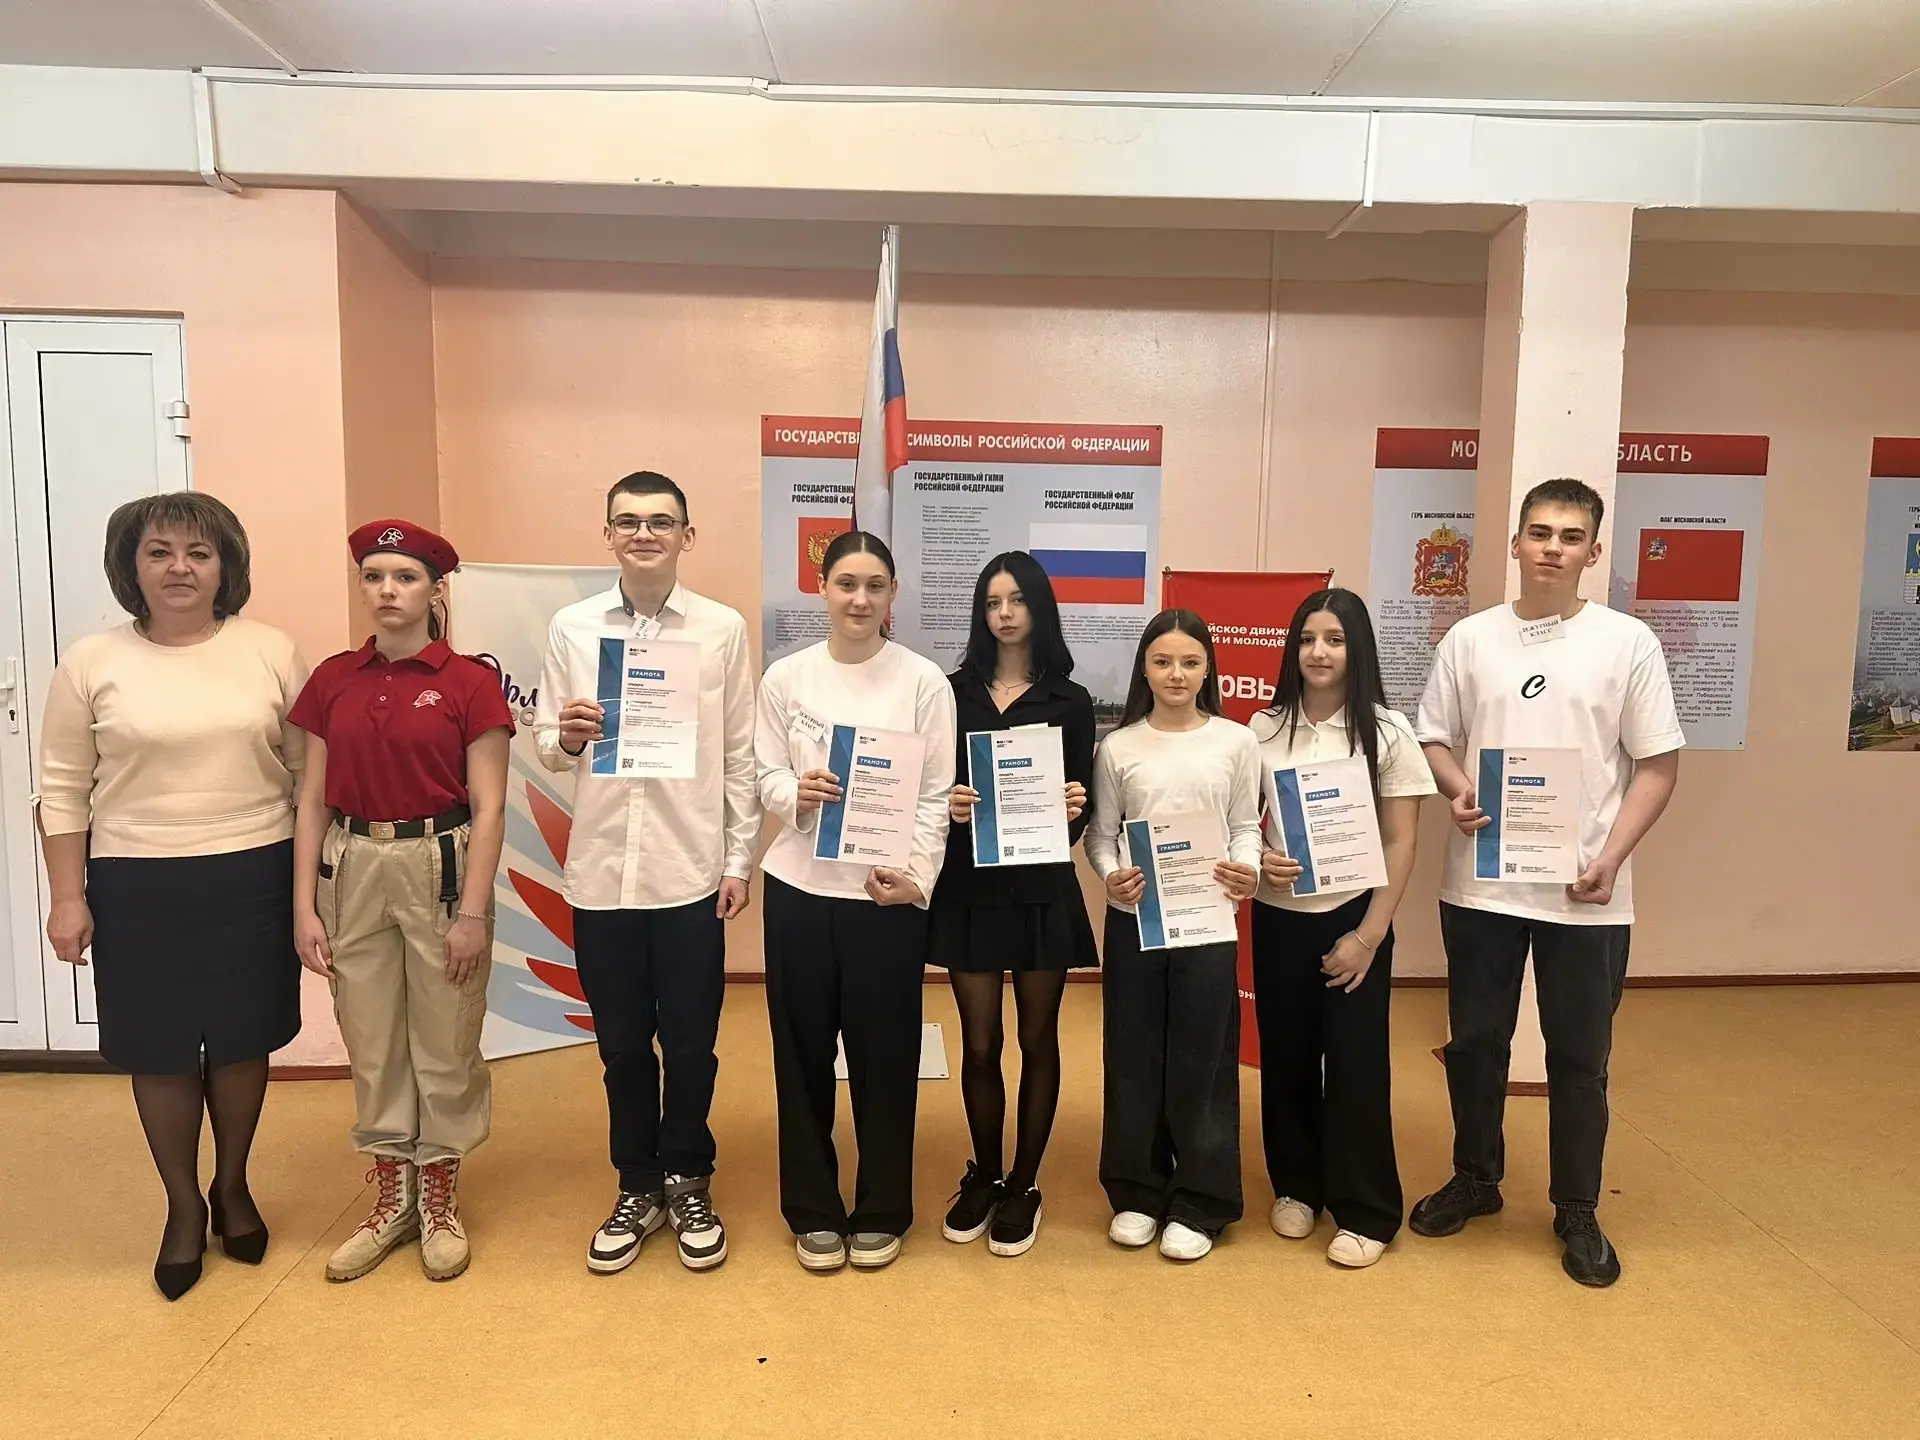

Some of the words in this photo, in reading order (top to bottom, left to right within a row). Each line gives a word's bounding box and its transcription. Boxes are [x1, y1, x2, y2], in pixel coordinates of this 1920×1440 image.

[908, 434, 972, 448] СИМВОЛЫ
[978, 434, 1065, 450] РОССИЙСКОЙ
[1072, 436, 1150, 452] ФЕДЕРАЦИИ
[1450, 440, 1477, 458] МО
[1617, 444, 1692, 462] БЛАСТЬ
[914, 472, 983, 482] ГОСУДАРСТВЕННЫЙ
[985, 474, 1004, 482] ГИМН
[914, 482, 960, 491] РОССИЙСКОЙ
[962, 484, 1004, 493] ФЕДЕРАЦИИ
[792, 494, 838, 504] РОССИЙСКОЙ
[840, 496, 854, 504] ФЕД
[1044, 490, 1113, 500] ГОСУДАРСТВЕННЫЙ
[1114, 492, 1134, 500] ФЛАГ
[1044, 501, 1090, 510] РОССИЙСКОЙ
[1092, 502, 1134, 511] ФЕДЕРАЦИИ
[1208, 623, 1247, 634] йское
[1211, 634, 1219, 644] й
[1233, 637, 1286, 648] молодё
